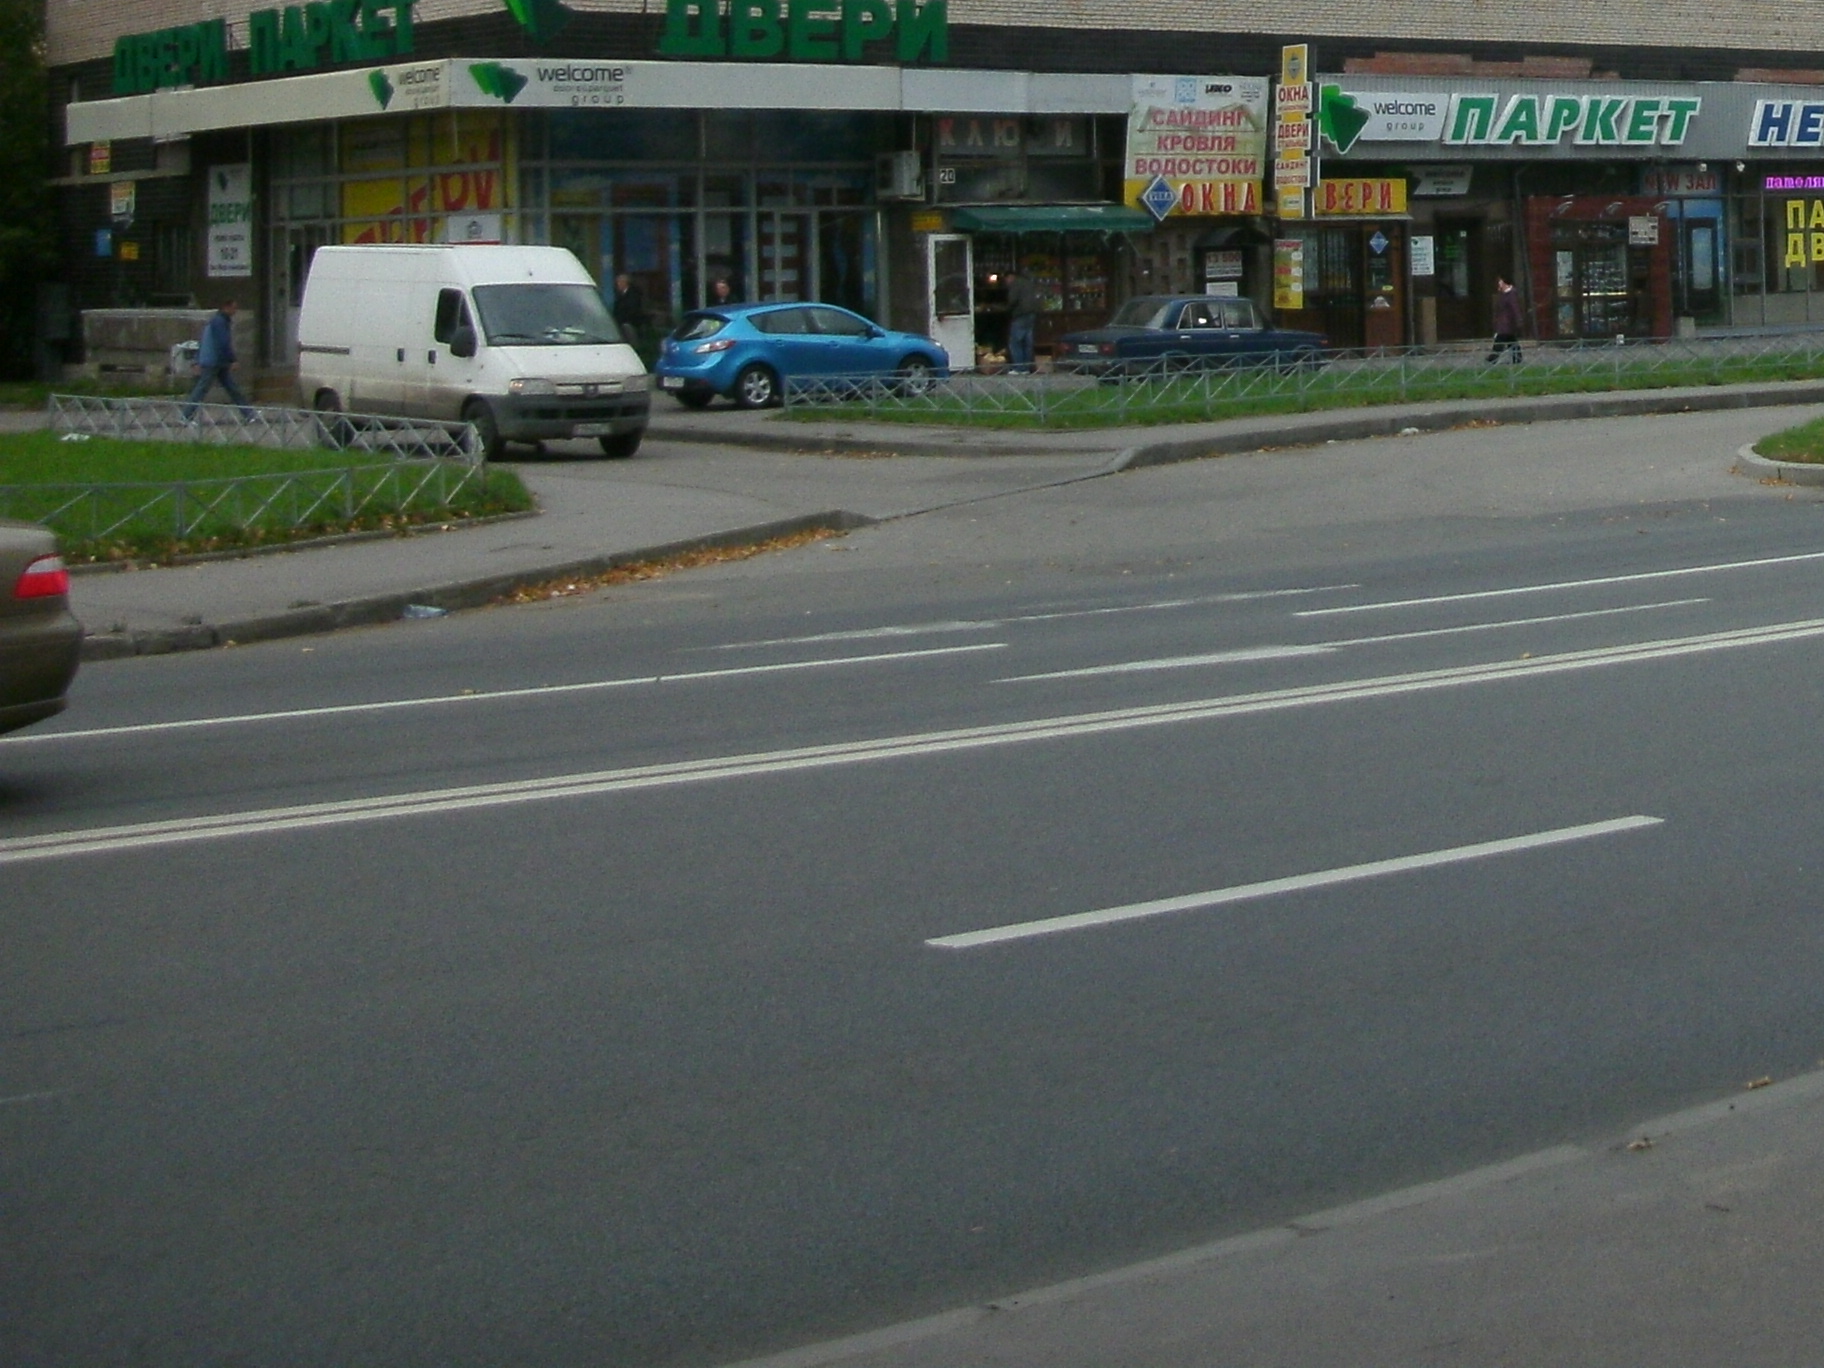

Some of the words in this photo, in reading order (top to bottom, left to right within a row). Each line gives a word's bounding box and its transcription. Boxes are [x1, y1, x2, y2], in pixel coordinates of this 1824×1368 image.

[112, 18, 229, 94] ДВЕРИ
[537, 64, 624, 82] welcome
[571, 94, 624, 106] group
[1278, 85, 1309, 102] ОКНА
[1151, 106, 1246, 128] САЙДИНГ
[1374, 100, 1436, 116] welcome
[1386, 121, 1425, 131] group
[1447, 94, 1700, 145] ПАРКЕТ
[939, 117, 1073, 147] КЛЮИ
[1277, 122, 1309, 138] ДВЕРИ
[1156, 135, 1236, 152] КРОВЛЯ
[1134, 158, 1257, 177] ВОДОСТОКИ
[1179, 182, 1257, 213] ОКНА
[1315, 181, 1392, 211] ВЕРИ
[210, 202, 250, 224] ДВЕРИ
